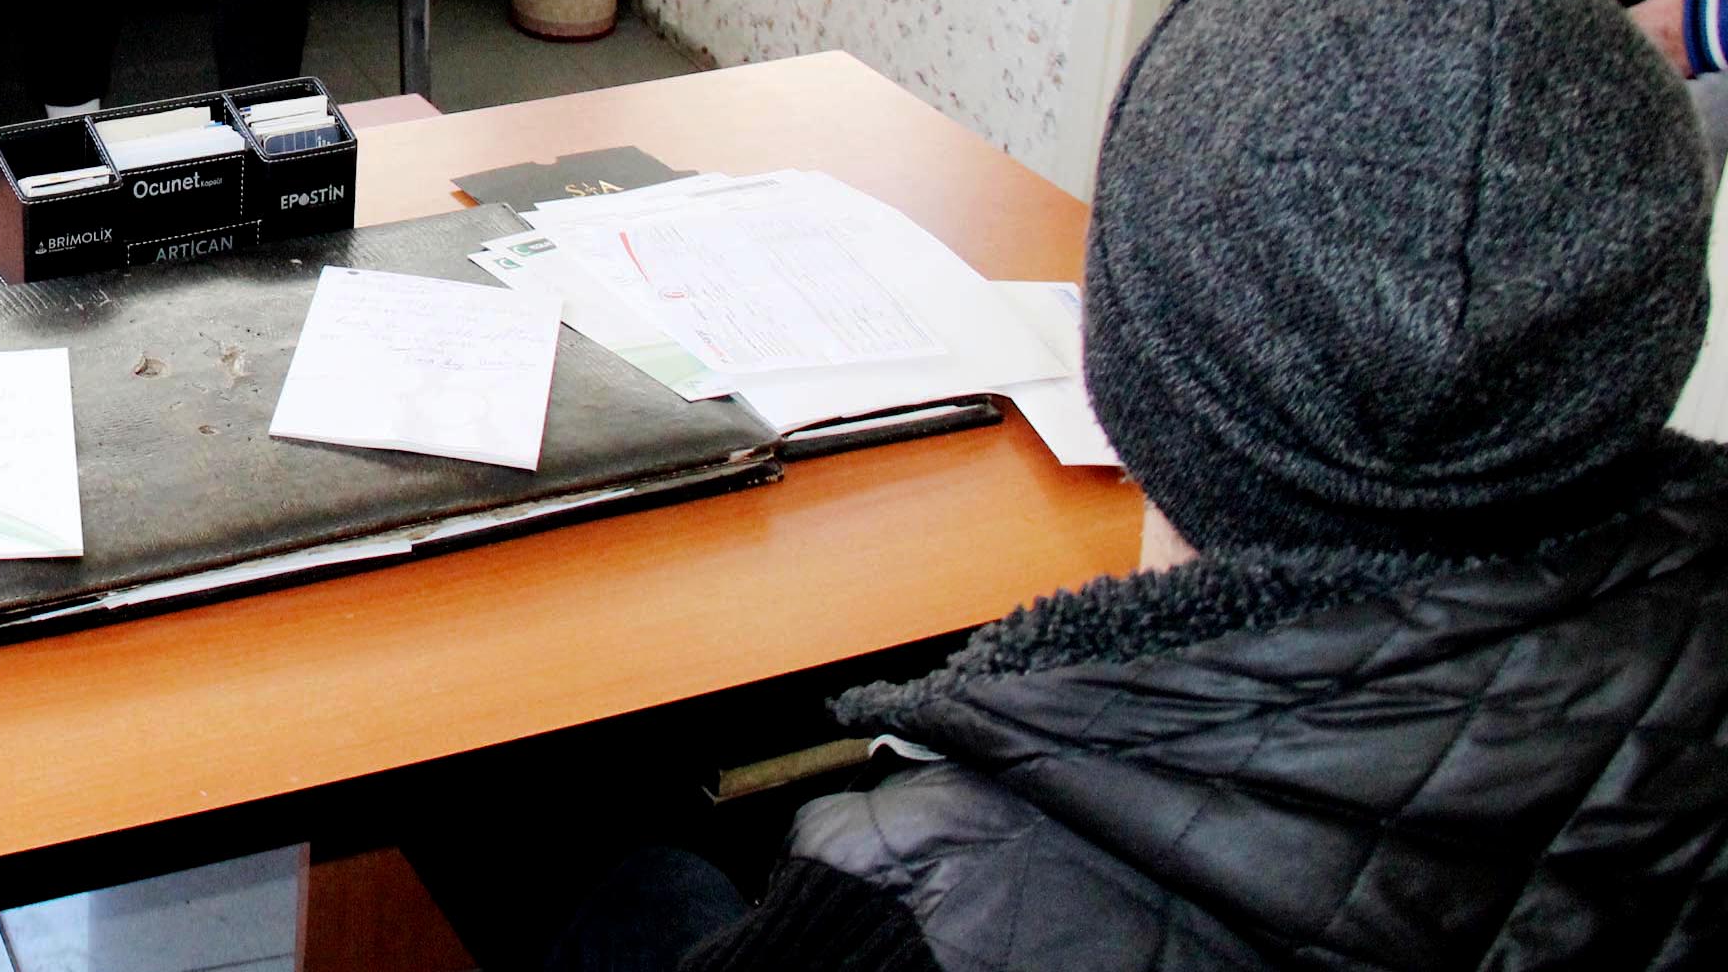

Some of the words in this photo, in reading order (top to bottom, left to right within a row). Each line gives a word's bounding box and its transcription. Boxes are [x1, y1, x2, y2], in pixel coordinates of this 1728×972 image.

[133, 171, 201, 199] Ocunet
[48, 228, 113, 250] BRİMOLİX
[156, 236, 234, 262] ARTİCAN
